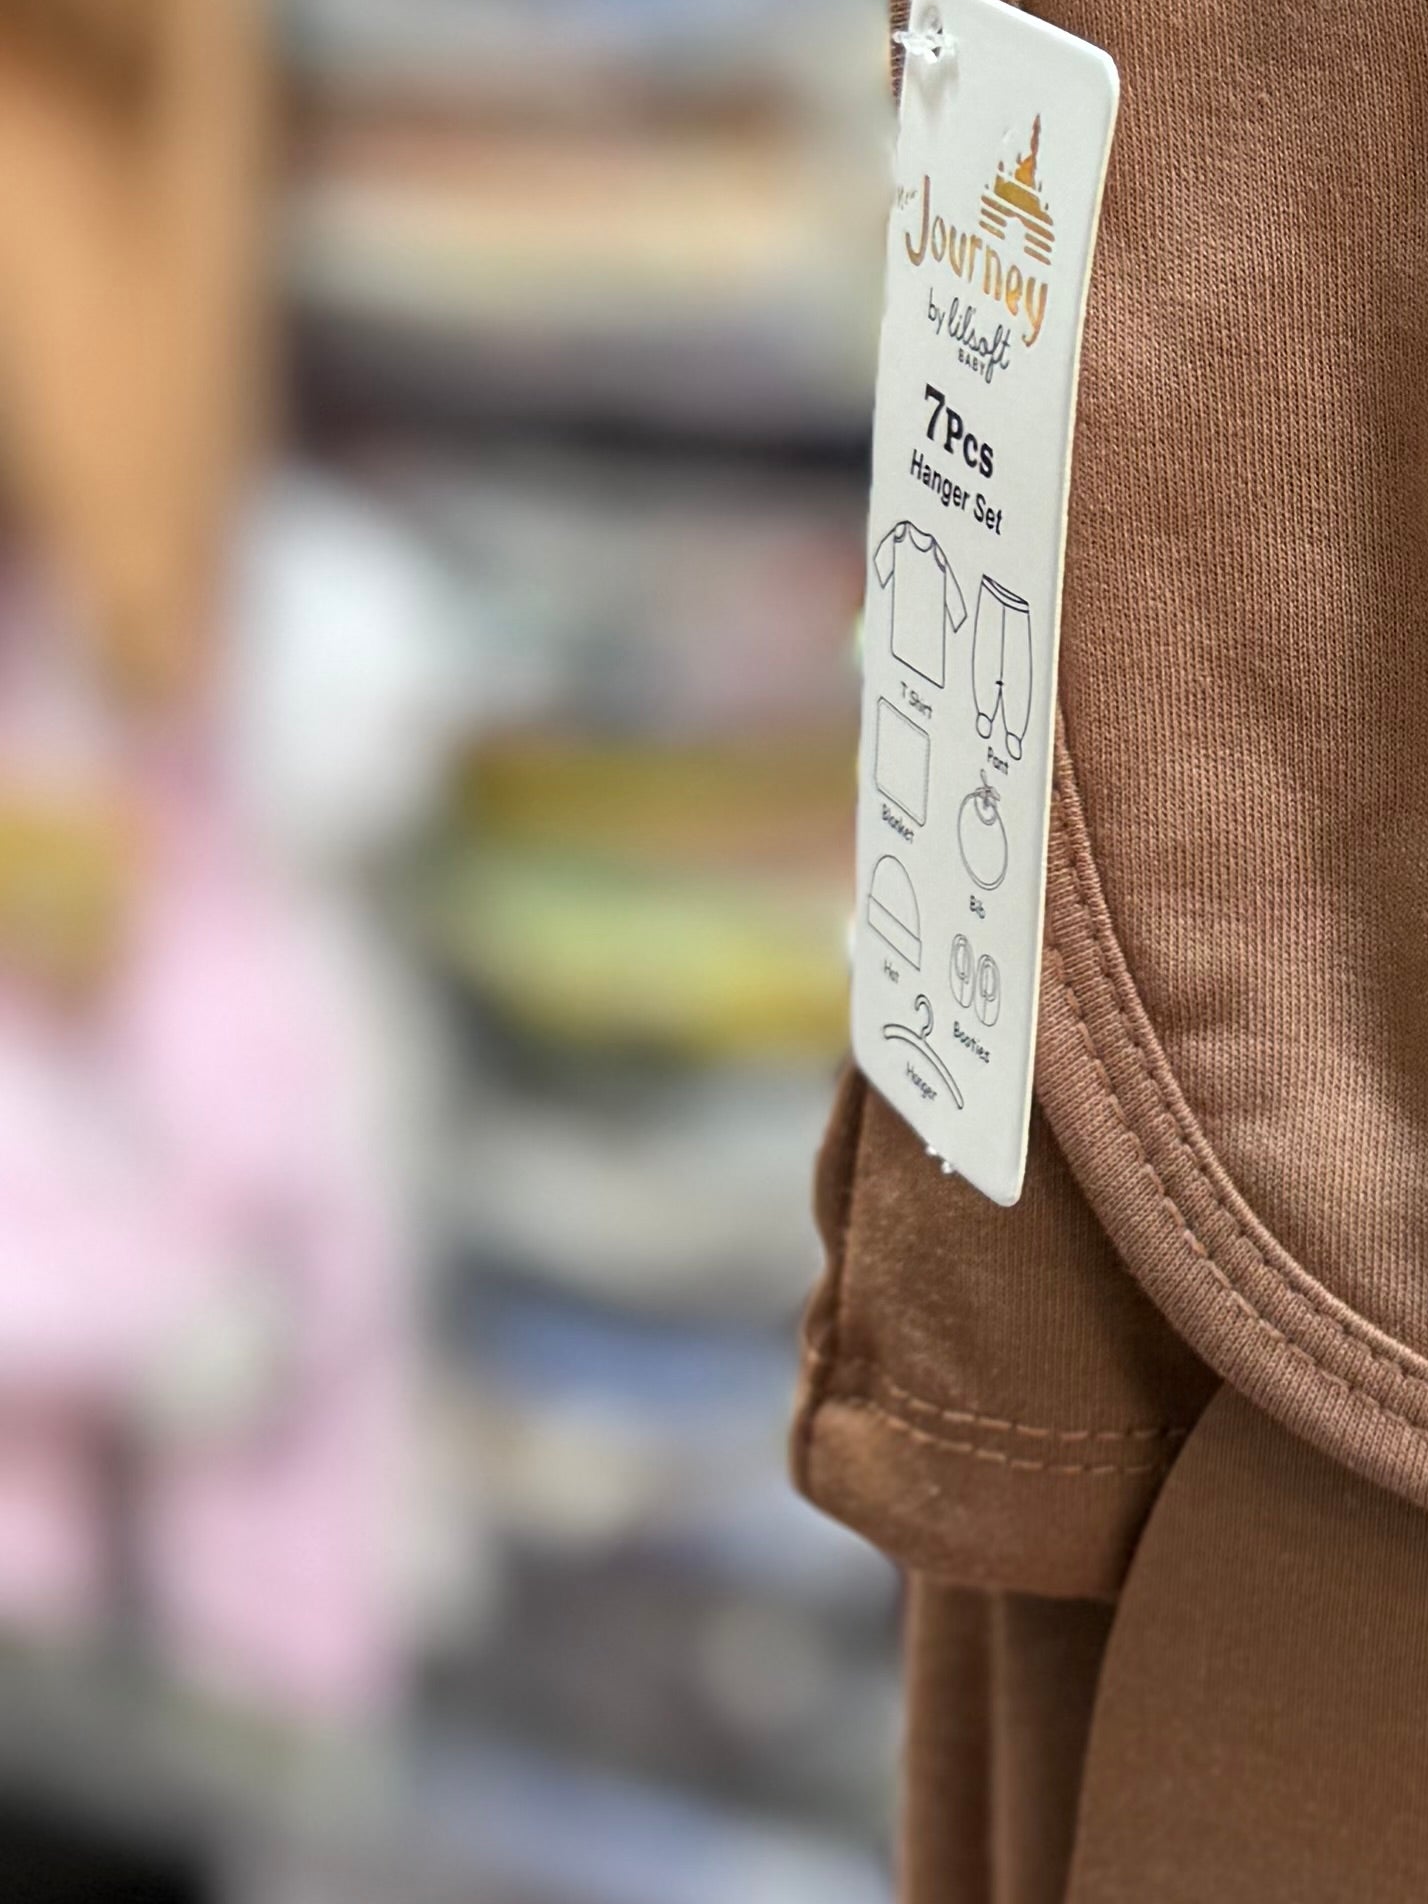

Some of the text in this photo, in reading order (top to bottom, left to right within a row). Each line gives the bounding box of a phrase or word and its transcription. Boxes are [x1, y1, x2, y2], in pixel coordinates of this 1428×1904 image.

[905, 174, 1048, 348] Journey
[928, 287, 945, 335] by
[924, 383, 995, 479] 7Pcs
[909, 449, 1002, 536] Hanger Set
